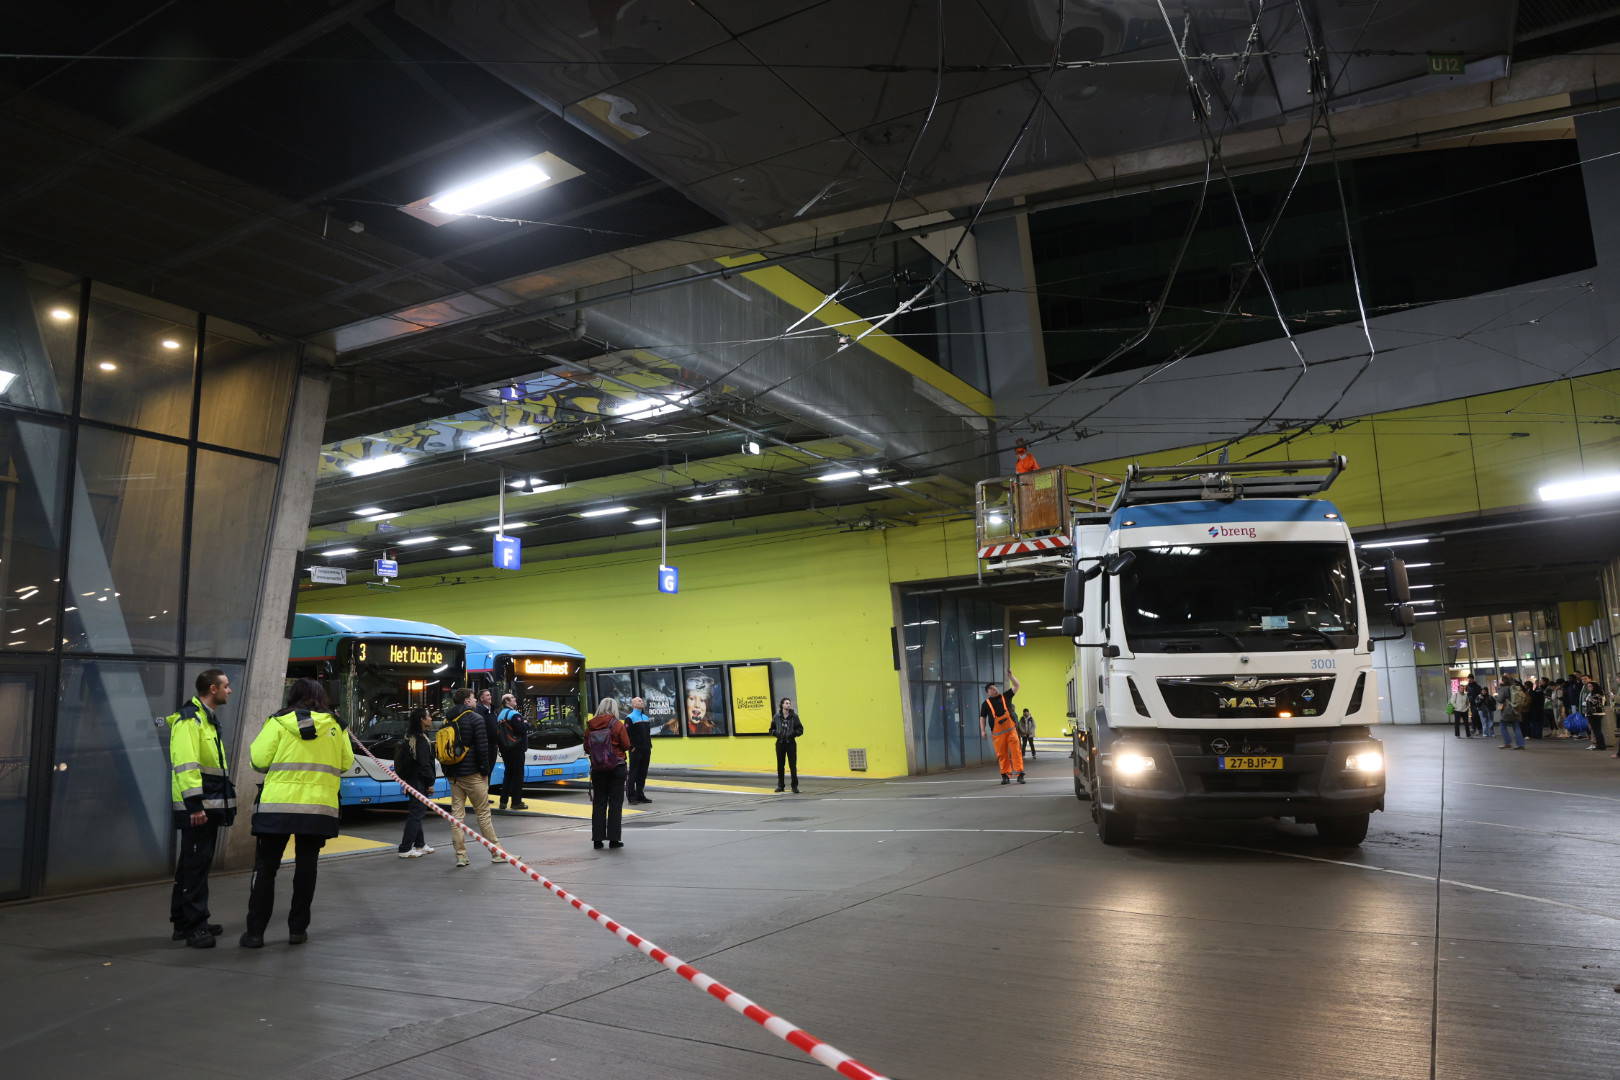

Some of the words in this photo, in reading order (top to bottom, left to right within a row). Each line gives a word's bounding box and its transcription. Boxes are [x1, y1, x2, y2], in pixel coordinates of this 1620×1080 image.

[1432, 57, 1460, 72] U12
[1220, 526, 1257, 538] breng
[504, 548, 513, 567] F
[665, 575, 674, 591] G
[359, 643, 367, 661] 3
[390, 644, 409, 663] Het
[410, 646, 443, 664] Duifje
[1311, 658, 1337, 669] 3001
[1219, 697, 1277, 708] MAN
[1230, 758, 1278, 768] 27-BJP-7
